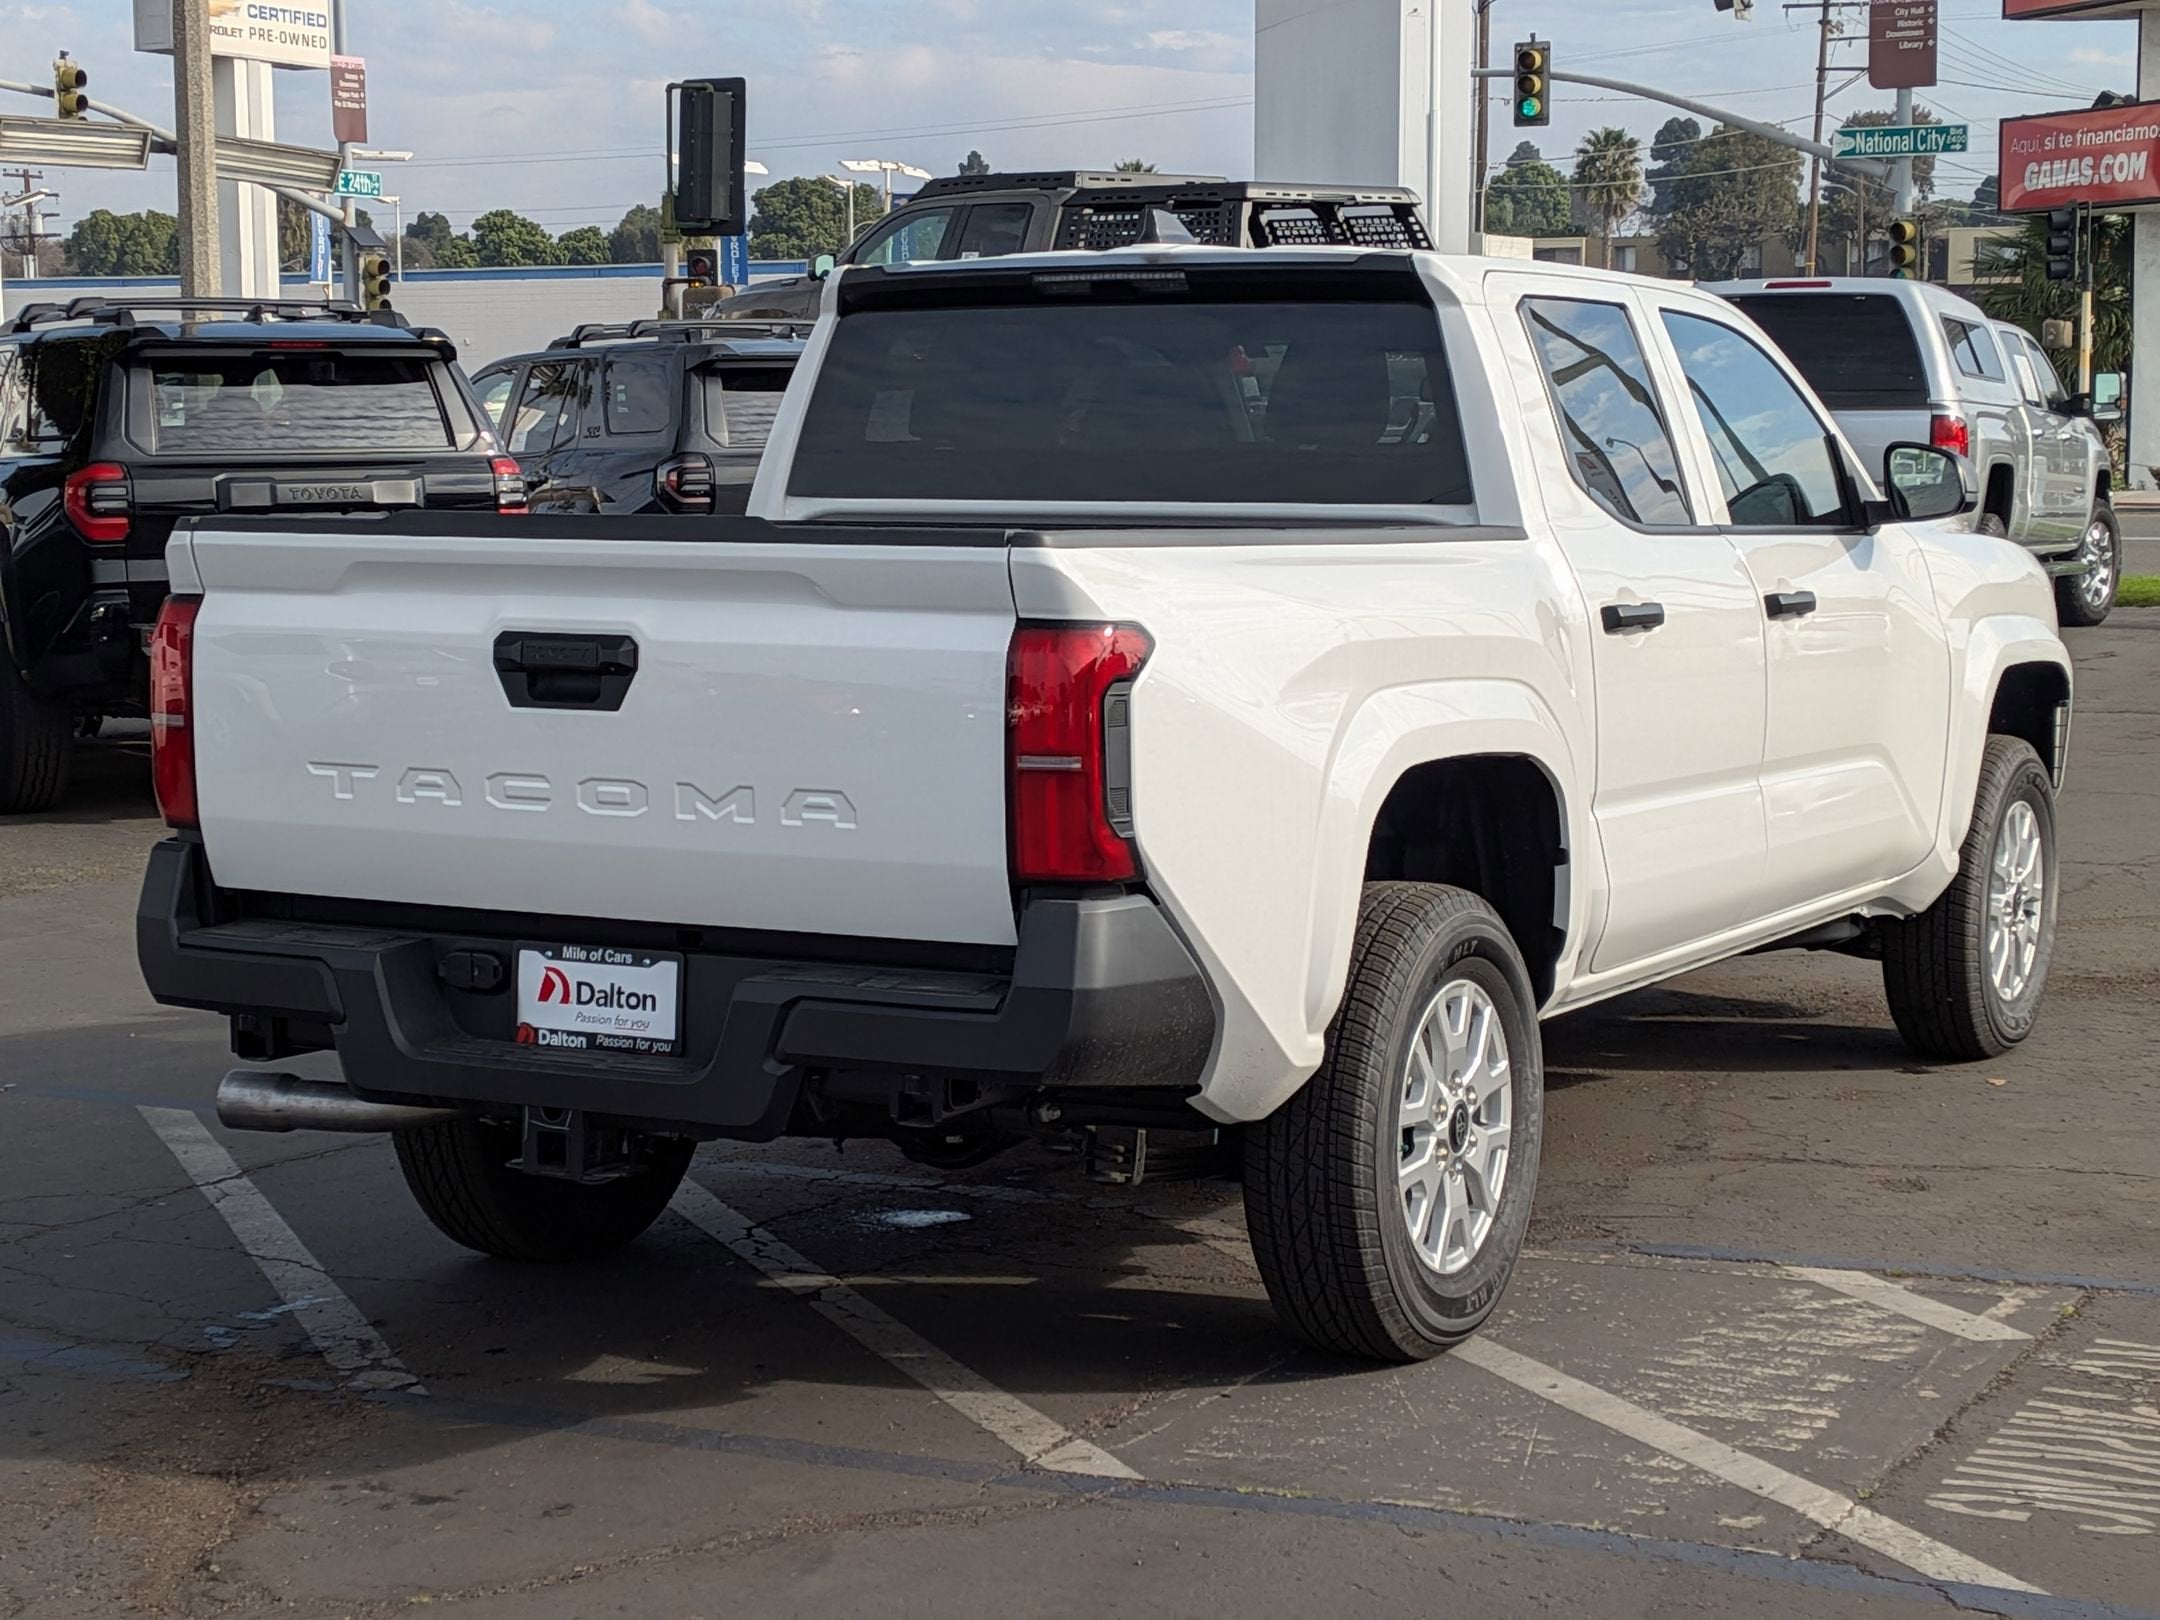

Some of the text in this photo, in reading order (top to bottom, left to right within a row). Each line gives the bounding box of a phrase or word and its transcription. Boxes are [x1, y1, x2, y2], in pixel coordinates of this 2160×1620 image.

[247, 4, 327, 28] CERTIFIED
[1894, 6, 1925, 18] City Hall
[210, 25, 327, 49] ROLET PRE-OWNED
[1898, 40, 1924, 50] Library
[1855, 130, 1914, 154] National
[1916, 128, 1947, 152] City
[2044, 131, 2057, 150] sí
[2059, 132, 2073, 149] te
[2076, 123, 2160, 147] financiamo
[338, 172, 372, 194] E 24th
[2024, 151, 2149, 192] GANAS.COM
[289, 486, 363, 501] TOYOTA
[307, 761, 859, 830] TACOMA
[562, 945, 633, 964] Mile of Cars
[575, 981, 657, 1012] Dalton
[574, 1011, 650, 1030] Passion for you
[538, 1029, 672, 1053] Dalton Passion for you
